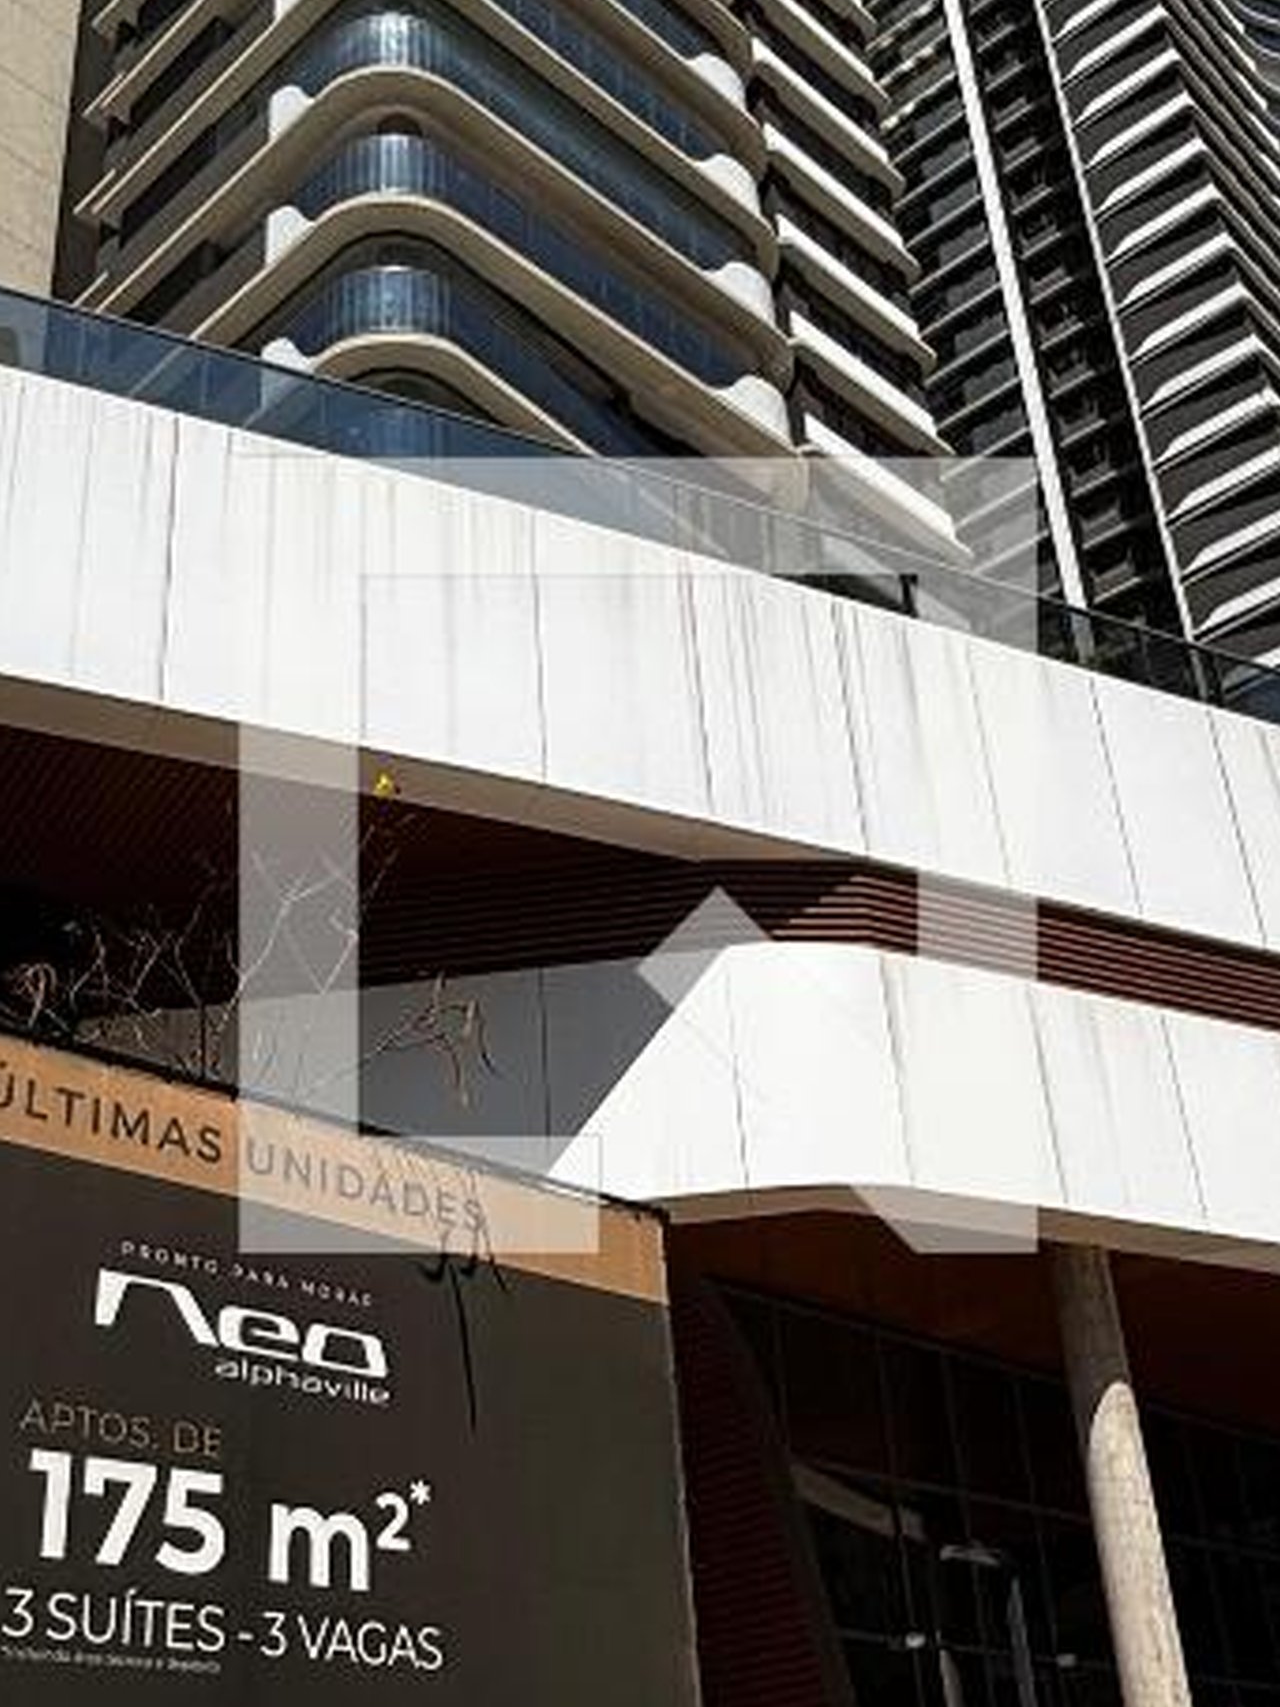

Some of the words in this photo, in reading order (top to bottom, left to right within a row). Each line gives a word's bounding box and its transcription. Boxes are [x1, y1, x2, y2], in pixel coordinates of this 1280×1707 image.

[247, 1141, 484, 1232] UNIDADES
[215, 1359, 391, 1404] alphaville
[174, 1420, 222, 1459] DE
[29, 1448, 226, 1575] 175
[0, 1587, 34, 1639] 3
[45, 1588, 226, 1653] SUÍTES
[297, 1615, 444, 1670] VAGAS
